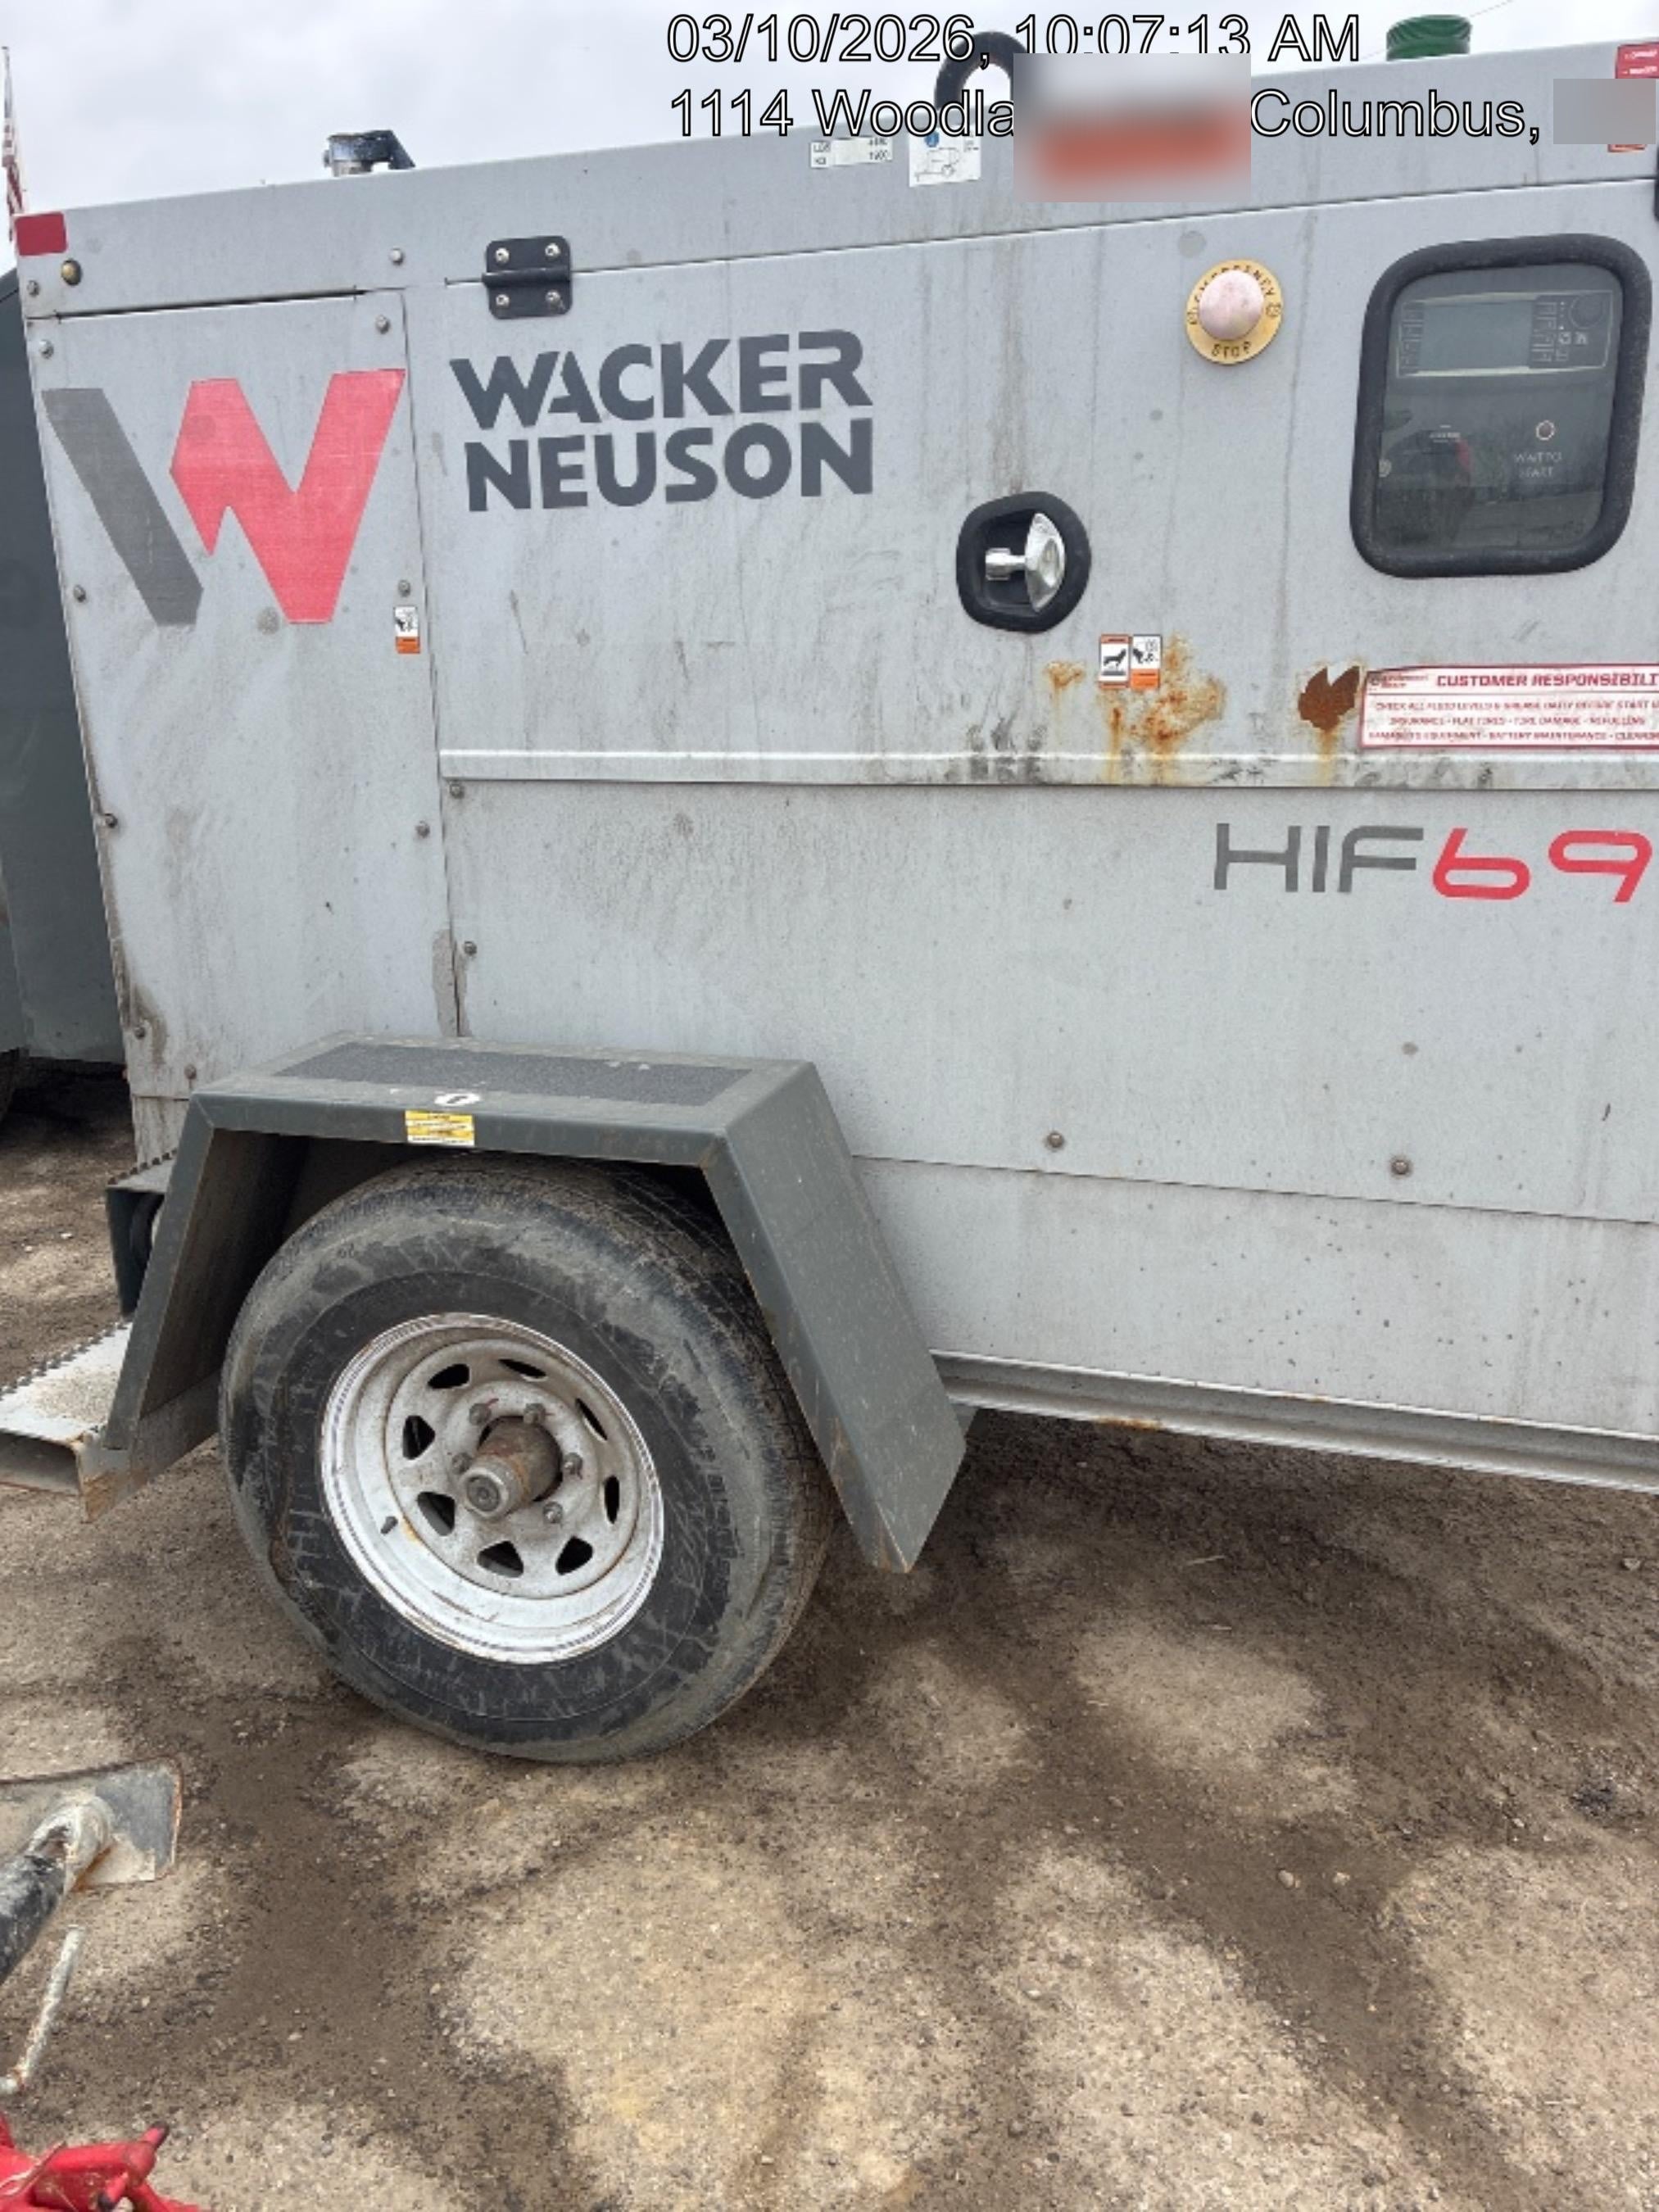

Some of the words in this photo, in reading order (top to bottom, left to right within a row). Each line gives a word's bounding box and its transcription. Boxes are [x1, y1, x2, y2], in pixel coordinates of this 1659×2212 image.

[1212, 341, 1253, 359] STOP
[450, 329, 873, 430] WACKER
[465, 418, 873, 512] NEUSON
[1436, 674, 1527, 687] CUSTOMER
[1531, 672, 1659, 687] RESPONSIBILI
